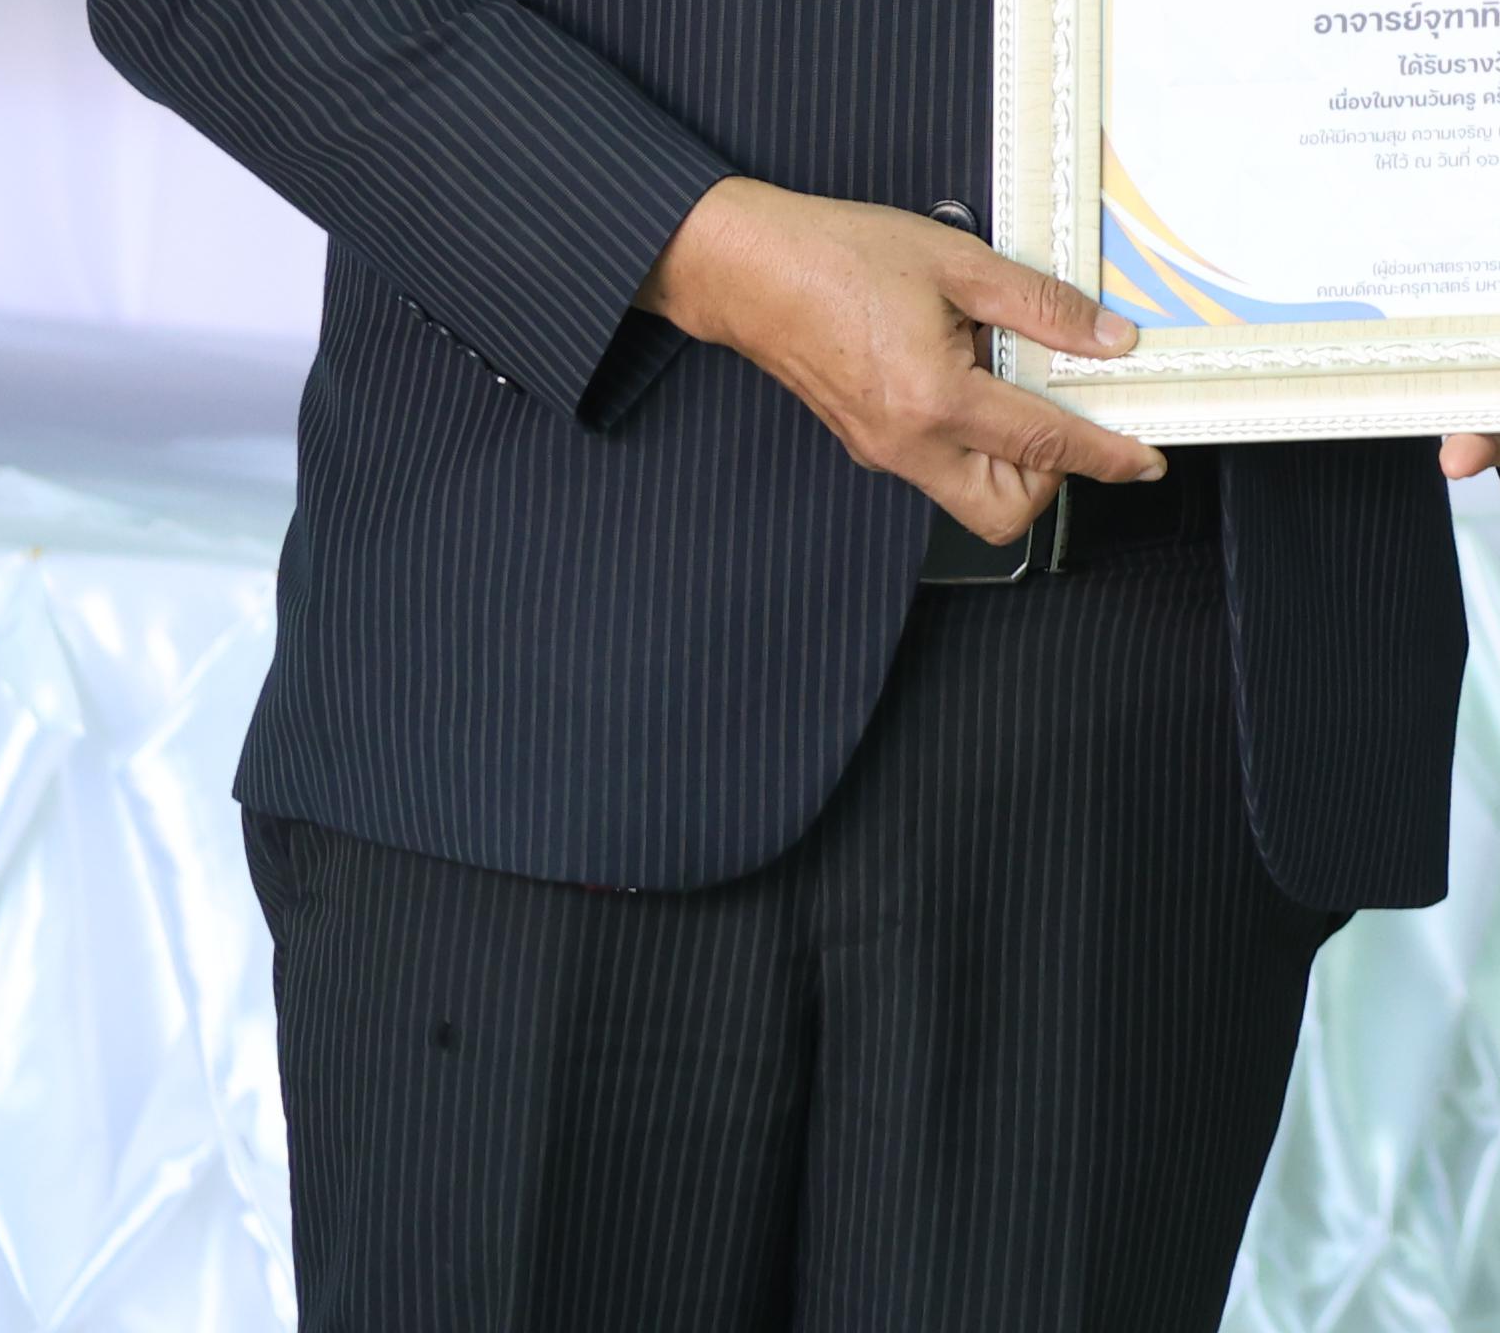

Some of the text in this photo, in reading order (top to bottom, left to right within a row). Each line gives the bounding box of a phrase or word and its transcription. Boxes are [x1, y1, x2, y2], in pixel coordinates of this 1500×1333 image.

[1328, 87, 1477, 112] เนื่องในงานวันครู
[1414, 156, 1432, 169] ณ
[1438, 146, 1470, 168] วันที่
